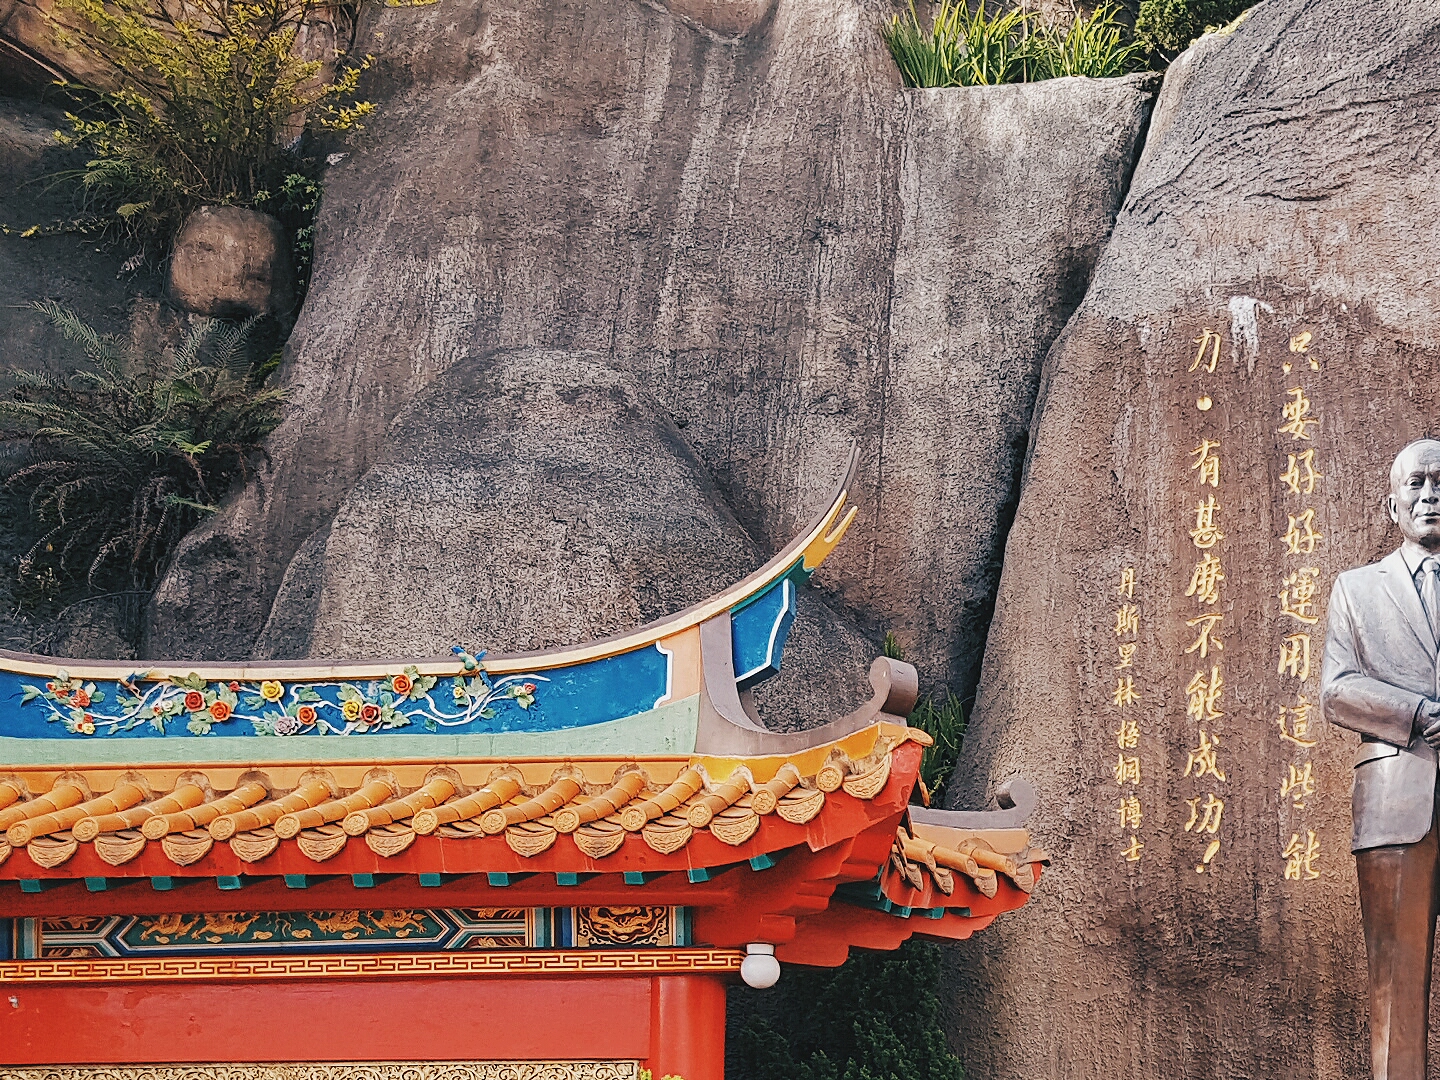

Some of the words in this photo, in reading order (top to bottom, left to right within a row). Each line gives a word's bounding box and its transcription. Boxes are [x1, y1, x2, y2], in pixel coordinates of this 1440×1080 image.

[1114, 567, 1142, 863] 丹斯里林梧桐博士
[1277, 331, 1322, 881] 只要好好運用這些能
